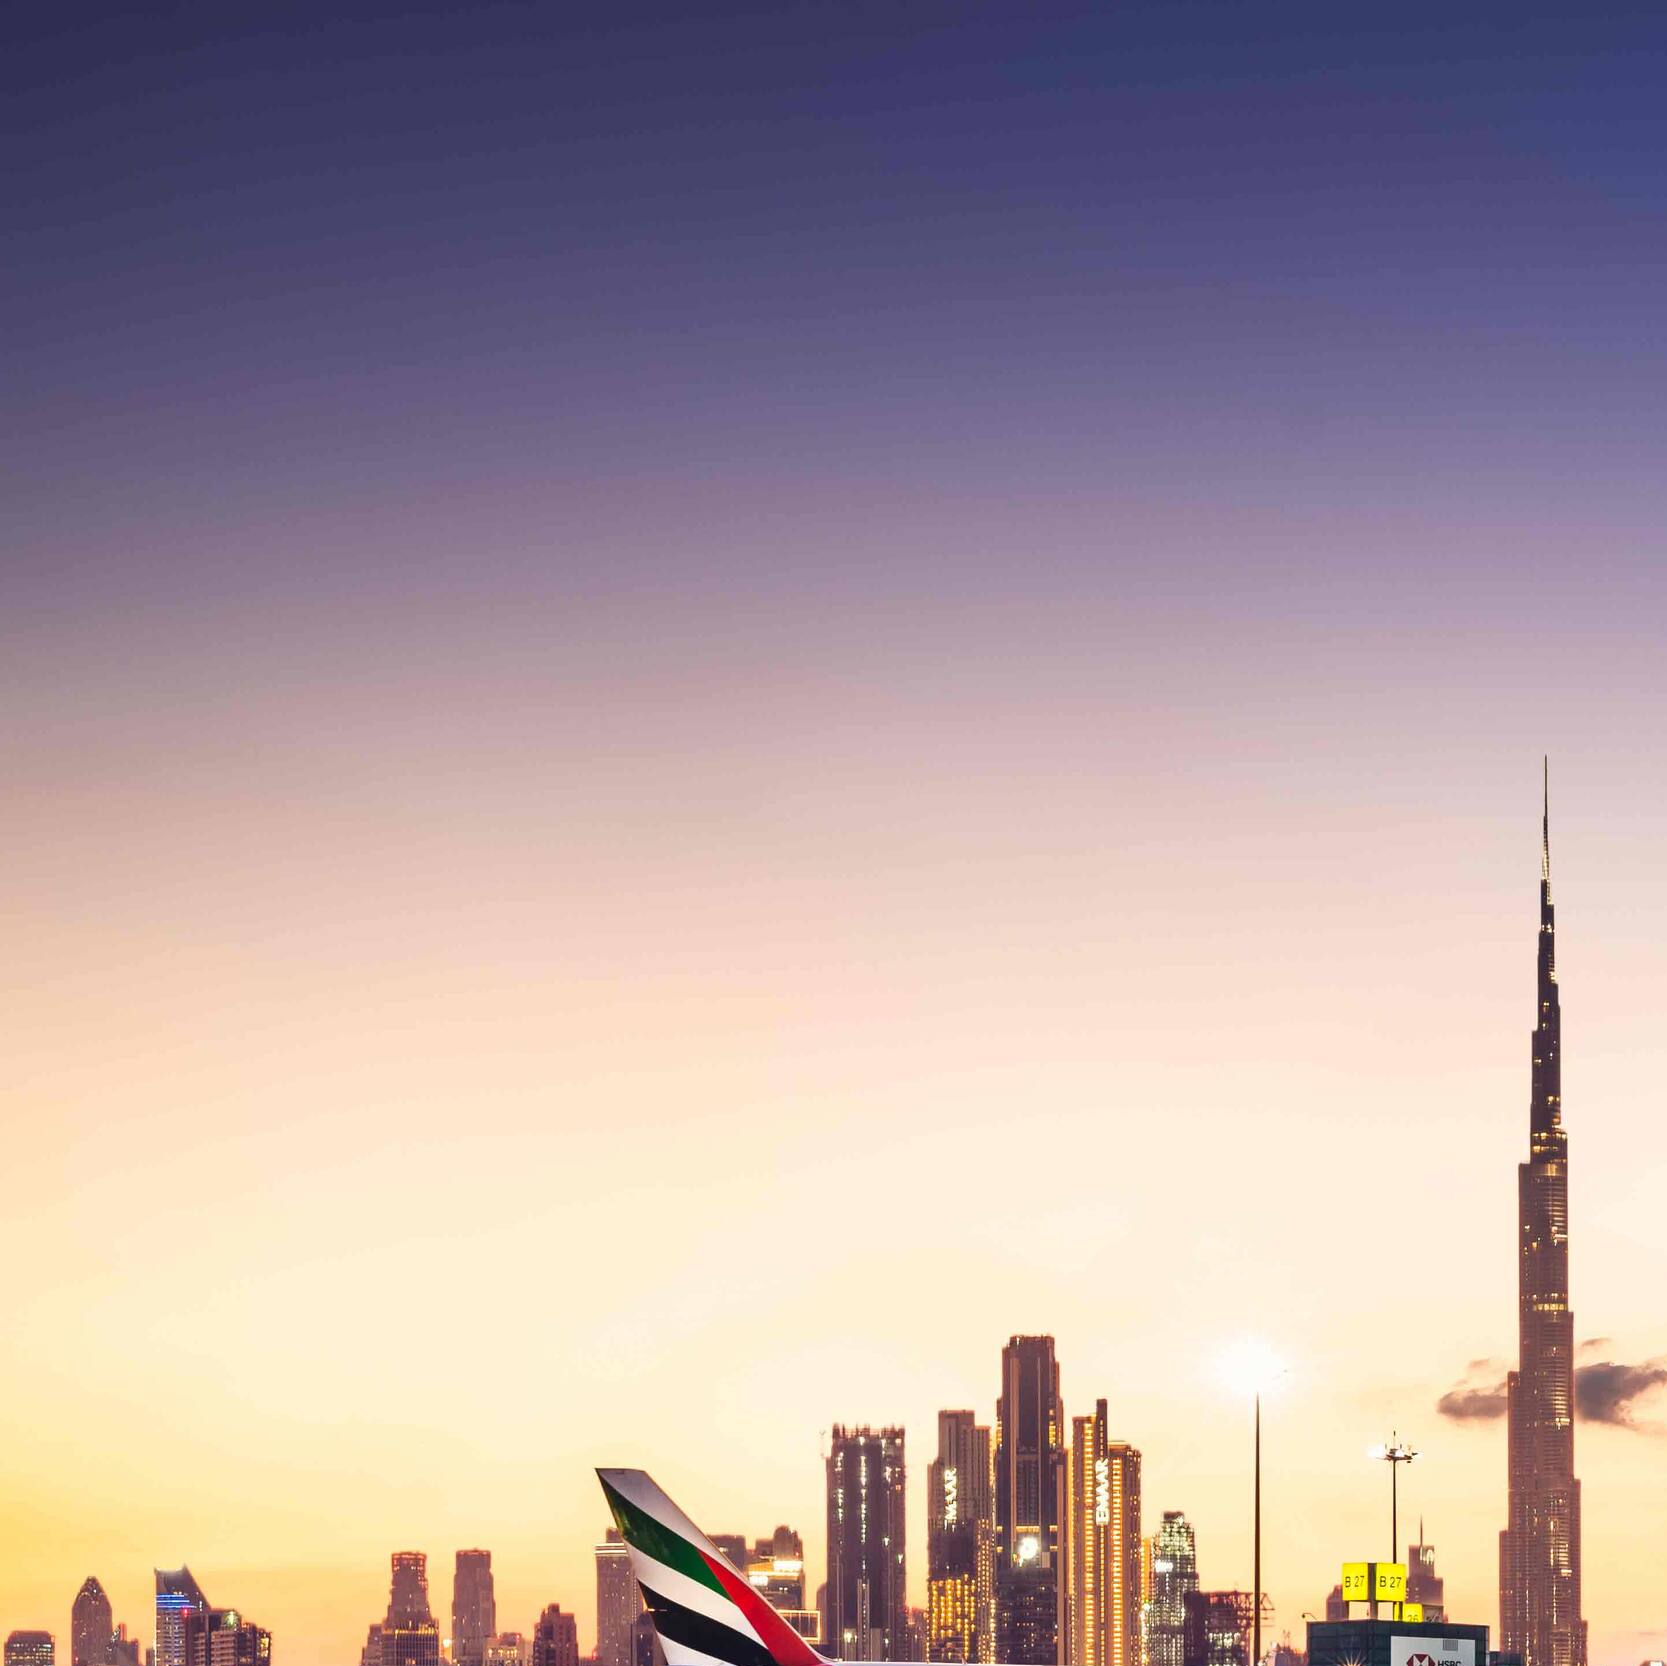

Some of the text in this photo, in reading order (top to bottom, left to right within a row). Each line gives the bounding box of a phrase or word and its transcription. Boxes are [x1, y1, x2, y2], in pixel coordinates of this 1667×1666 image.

[944, 1468, 958, 1531] MAAR
[1095, 1458, 1110, 1526] EMAAR
[1344, 1575, 1365, 1588] B 27
[1379, 1575, 1402, 1588] B 27
